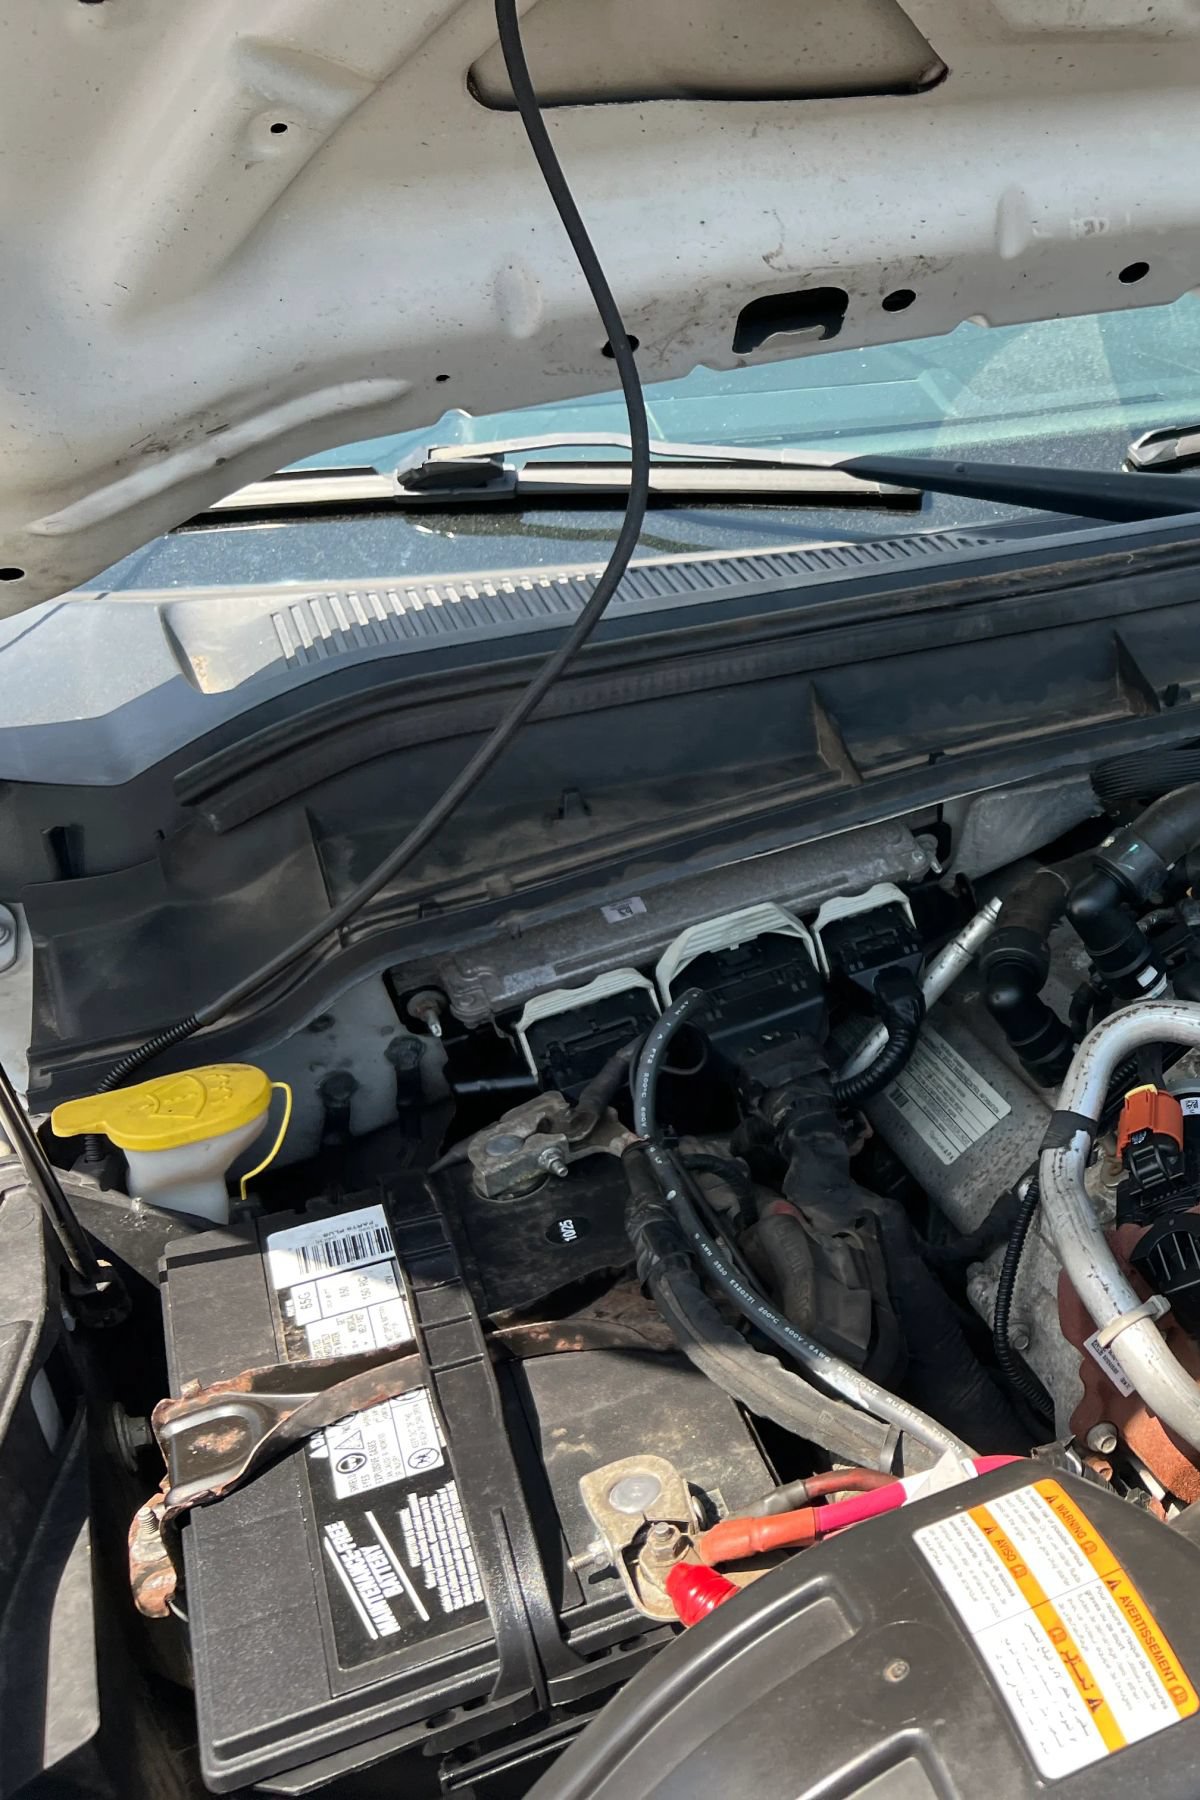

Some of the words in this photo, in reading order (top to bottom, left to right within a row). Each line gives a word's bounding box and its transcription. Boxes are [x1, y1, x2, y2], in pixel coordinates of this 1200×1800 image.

[836, 1365, 879, 1396] SILICONE
[884, 1396, 923, 1424] RUBBER
[1055, 1502, 1087, 1539] WARNING
[324, 1519, 401, 1637] MAINTENANCE-FREE
[359, 1543, 404, 1598] BATTERY
[993, 1538, 1016, 1562] AVISO
[1118, 1592, 1178, 1684] AVERTISSEMENT
